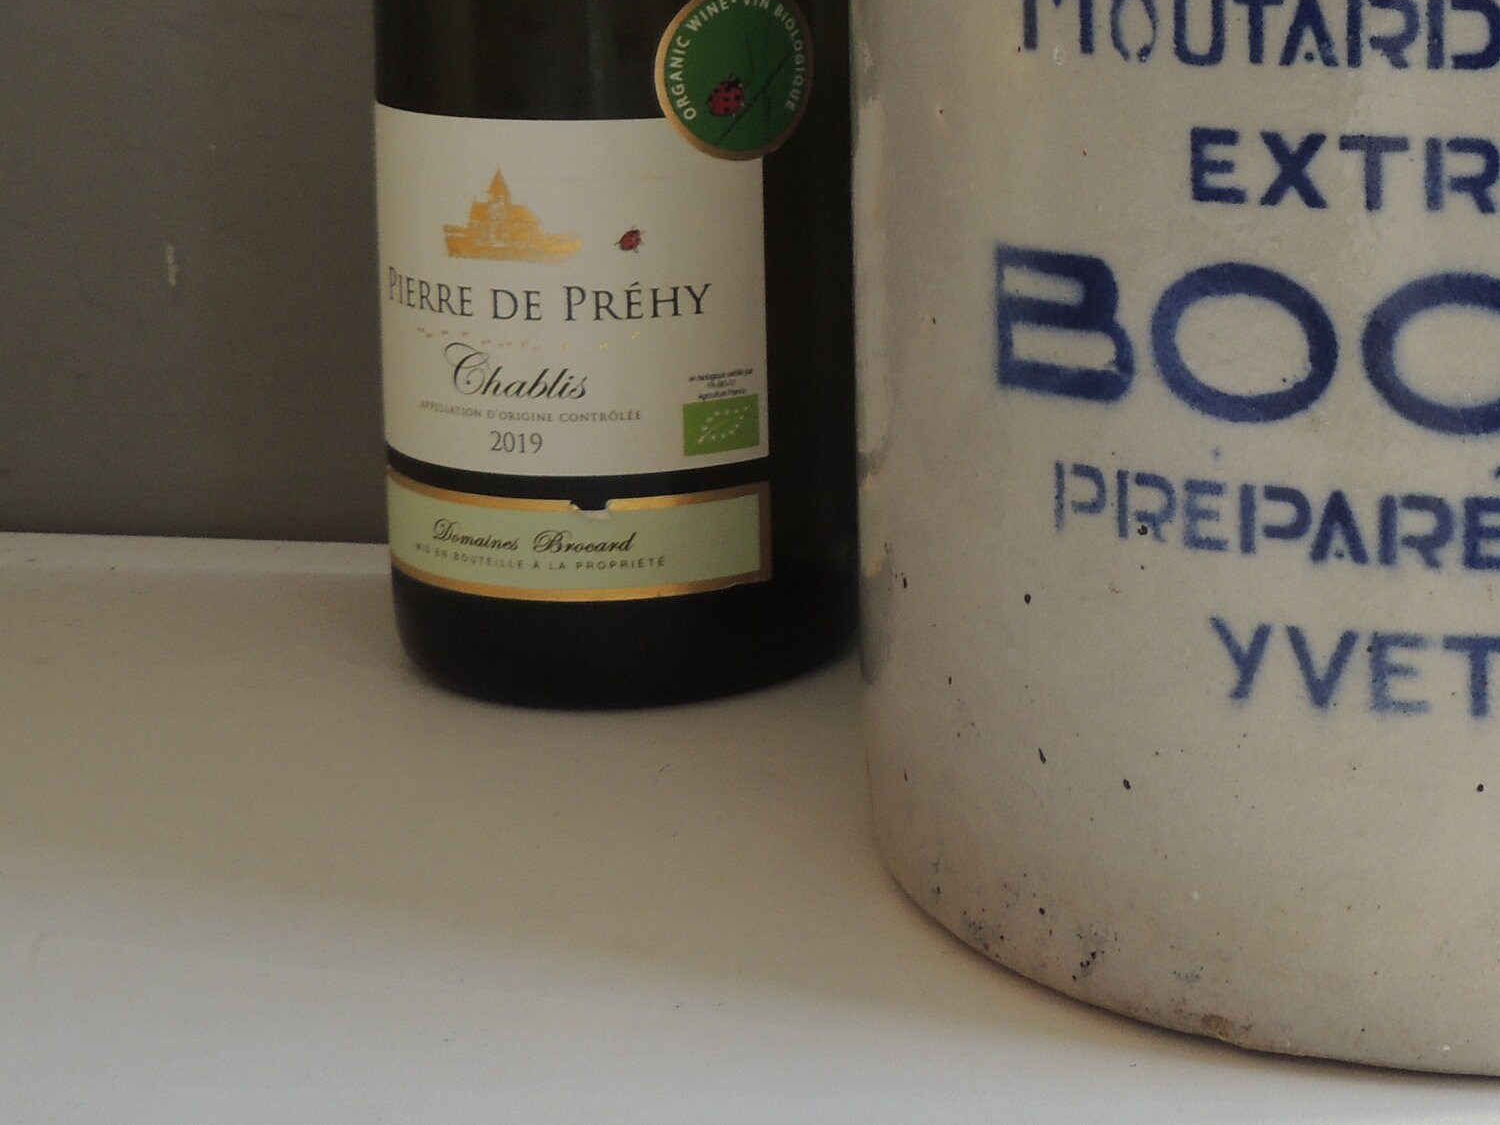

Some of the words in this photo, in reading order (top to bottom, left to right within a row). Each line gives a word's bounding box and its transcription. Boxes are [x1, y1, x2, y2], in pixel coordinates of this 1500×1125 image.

[669, 35, 697, 121] ORGANIC
[773, 3, 806, 112] BIOLOGIQUE
[388, 265, 474, 317] PIERRE
[490, 288, 543, 321] DE
[563, 281, 713, 321] PRÉHY
[444, 341, 588, 400] Chablis
[486, 409, 553, 423] D'ORIGINE
[559, 409, 642, 423] CONTRÔLÉE
[489, 430, 544, 455] 2019
[432, 518, 520, 552] Domaines
[533, 530, 638, 554] Brocard
[453, 552, 525, 570] BOUTEILLE
[549, 562, 566, 571] LA
